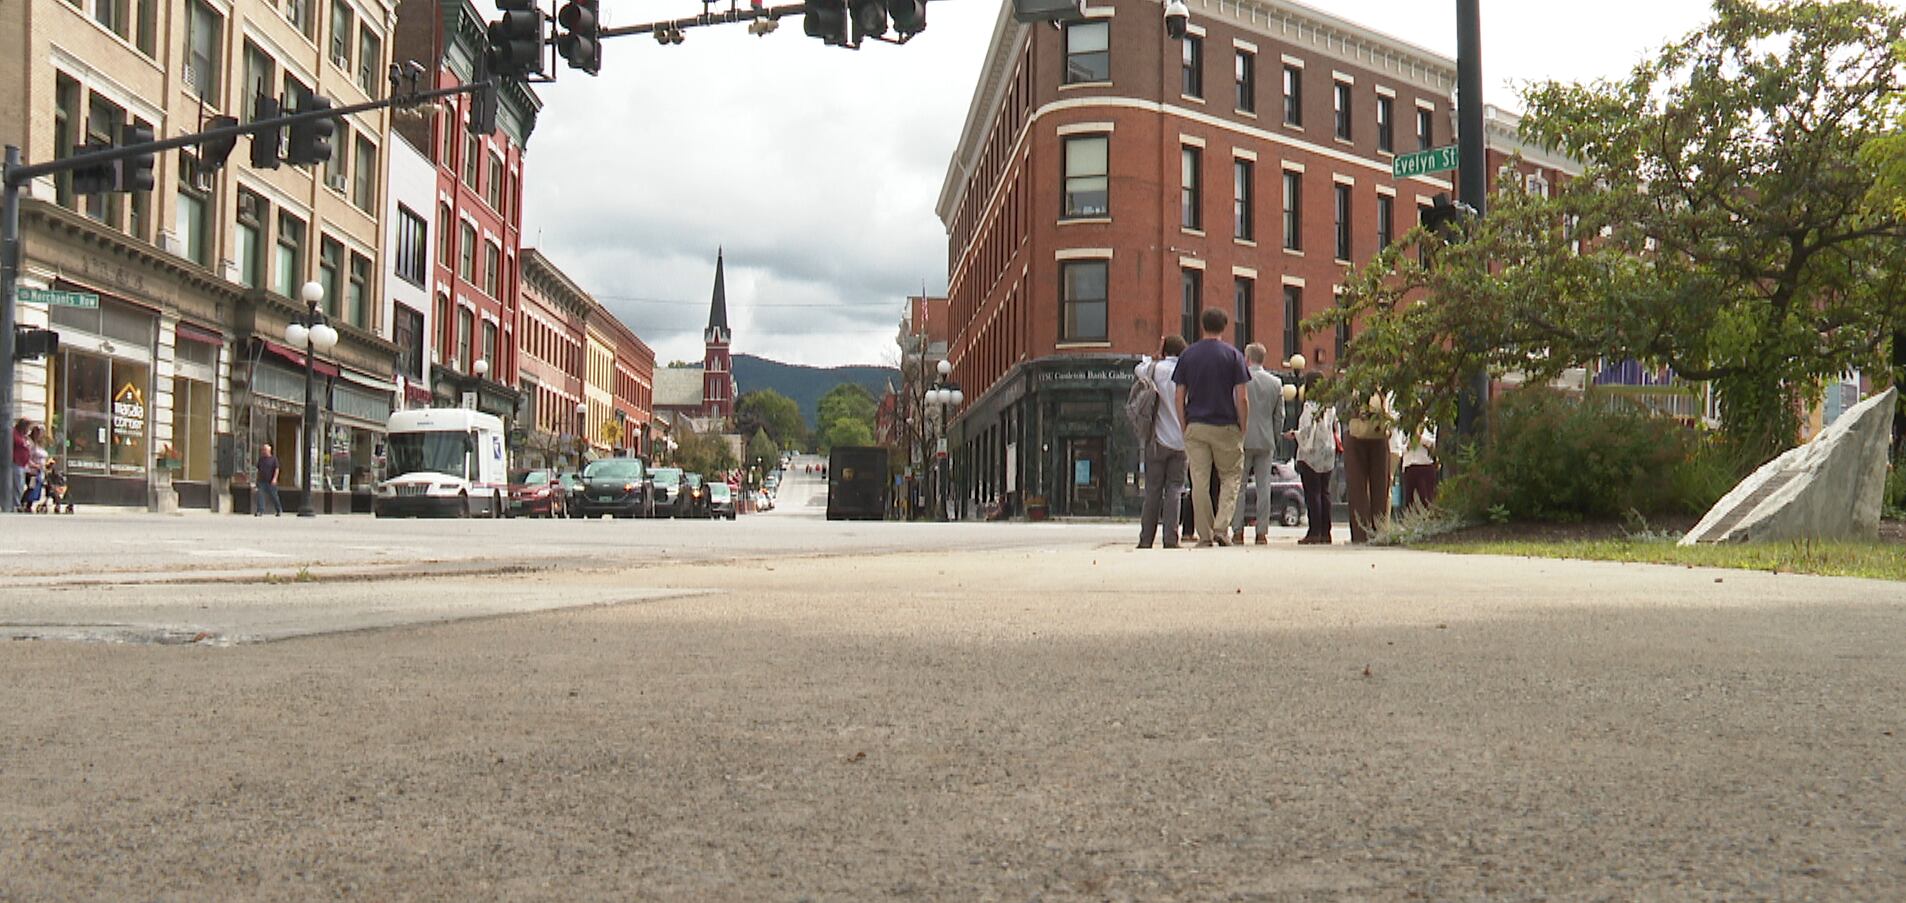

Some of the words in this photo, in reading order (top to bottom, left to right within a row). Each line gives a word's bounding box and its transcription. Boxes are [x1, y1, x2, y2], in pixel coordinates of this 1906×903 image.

[1395, 155, 1435, 175] Evelyn
[1442, 148, 1456, 168] St
[31, 291, 75, 304] Merchants
[1087, 369, 1107, 380] Bank
[1108, 370, 1135, 382] Gallery
